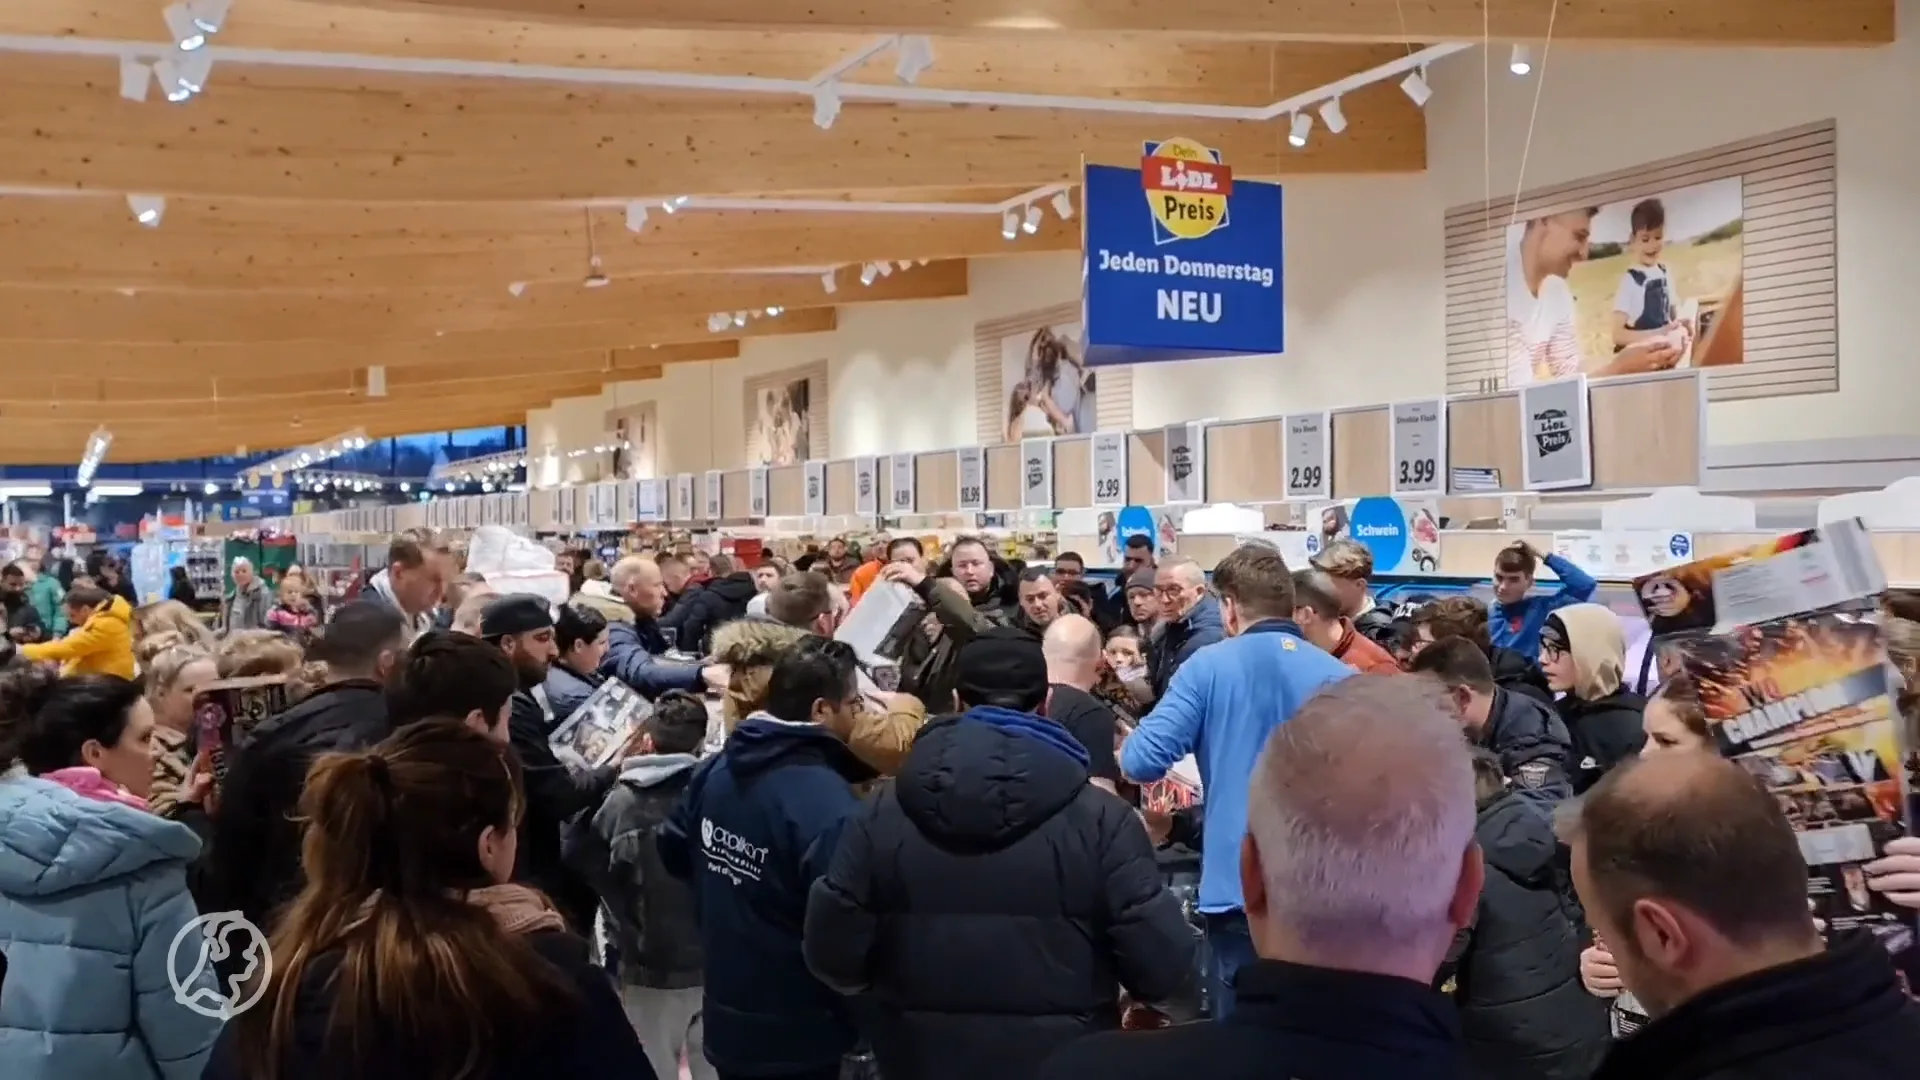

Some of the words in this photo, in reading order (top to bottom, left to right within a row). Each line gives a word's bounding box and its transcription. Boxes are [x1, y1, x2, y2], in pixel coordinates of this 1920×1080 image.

[1164, 195, 1215, 221] Preis
[1099, 249, 1159, 274] Jeden
[1164, 255, 1274, 287] Donnerstag
[1157, 288, 1222, 323] NEU
[1542, 433, 1566, 447] Preis
[1290, 466, 1322, 489] 2.99
[1399, 459, 1436, 484] 3.99
[1097, 479, 1119, 497] 2.99
[1356, 522, 1399, 537] Schwein
